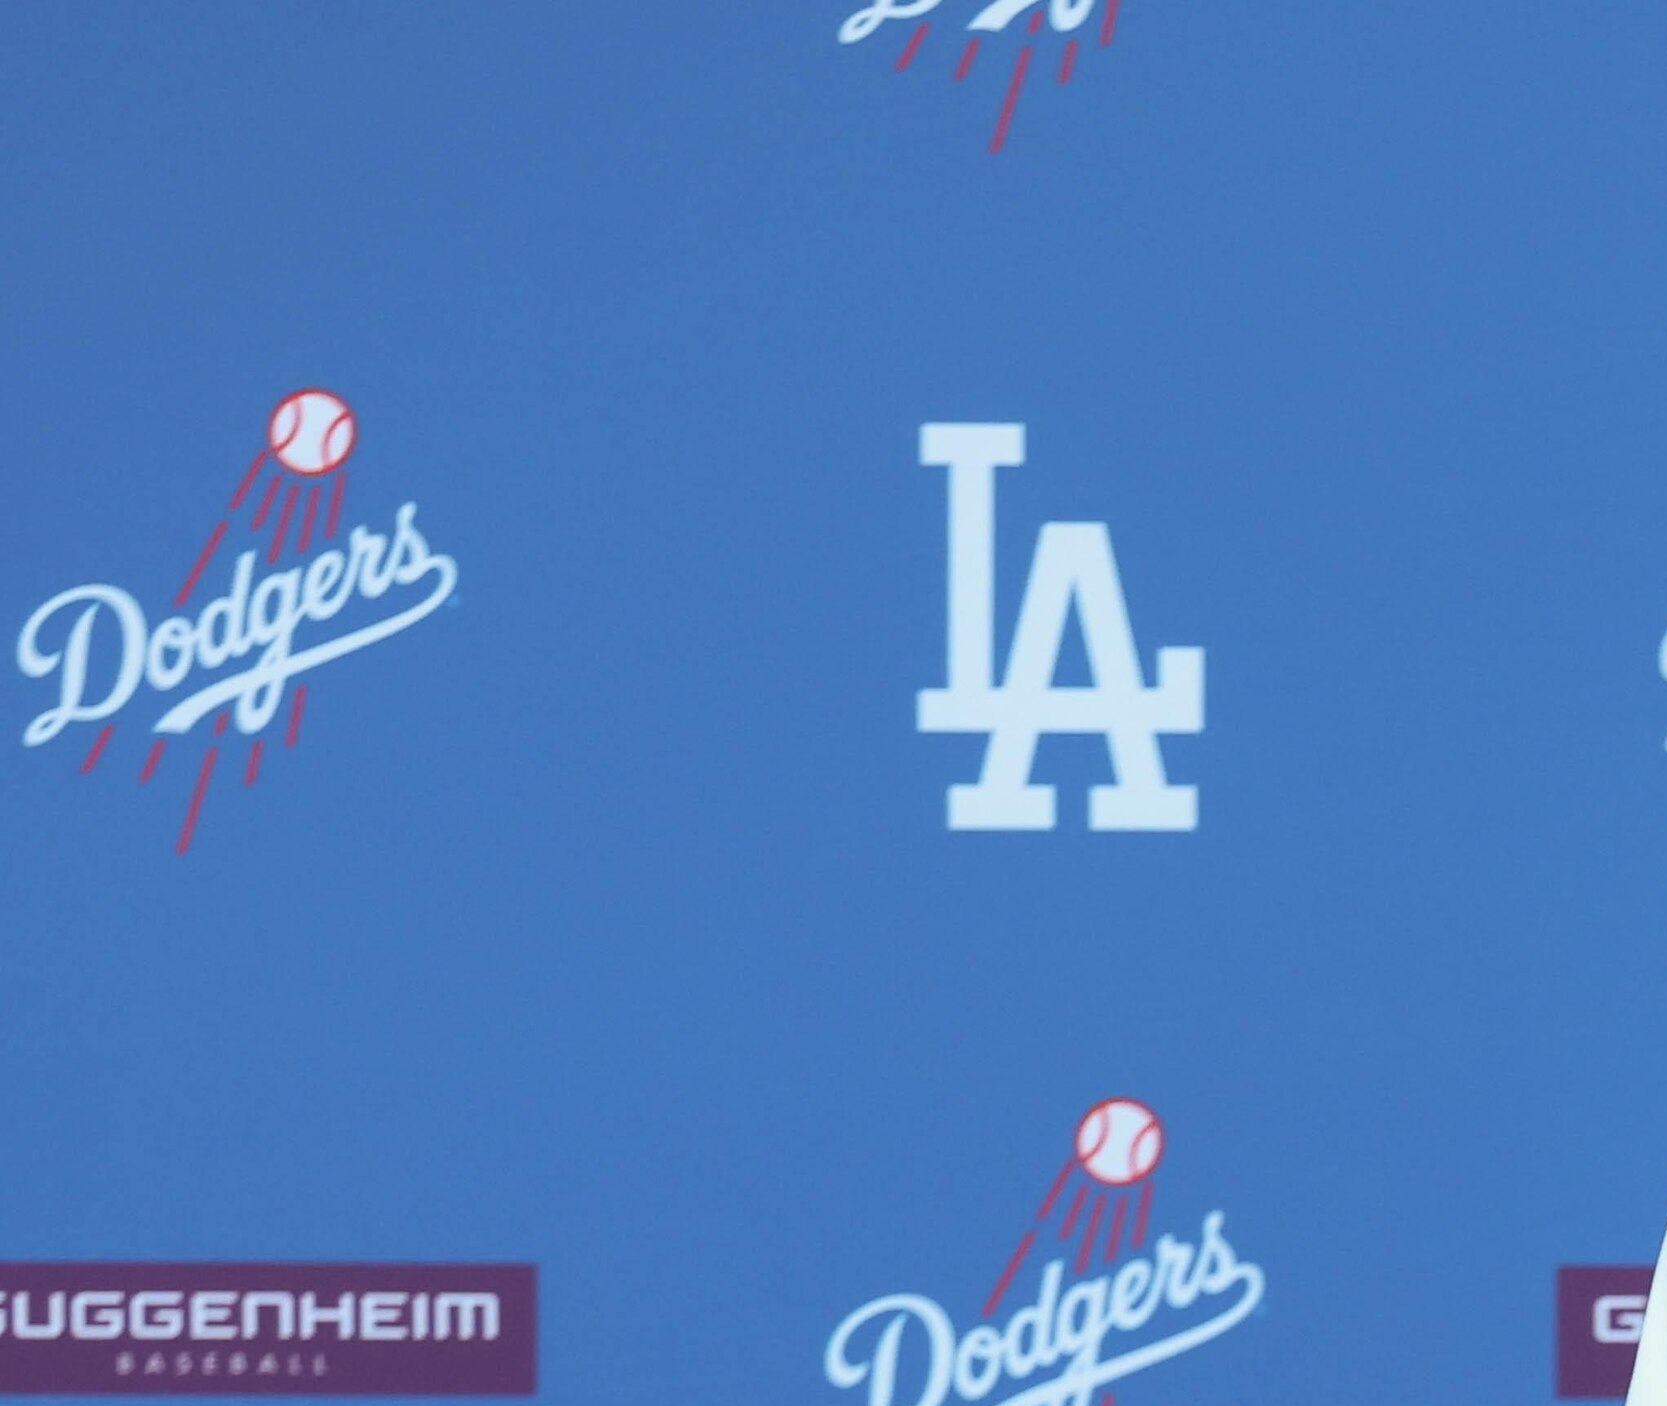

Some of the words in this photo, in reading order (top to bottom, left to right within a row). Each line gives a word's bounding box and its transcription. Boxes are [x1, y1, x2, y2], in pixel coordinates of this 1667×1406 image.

[17, 501, 458, 747] Dodgers
[916, 421, 1206, 832] LA
[0, 1290, 500, 1341] UGGENHEIM
[115, 1351, 329, 1378] BASEBALL
